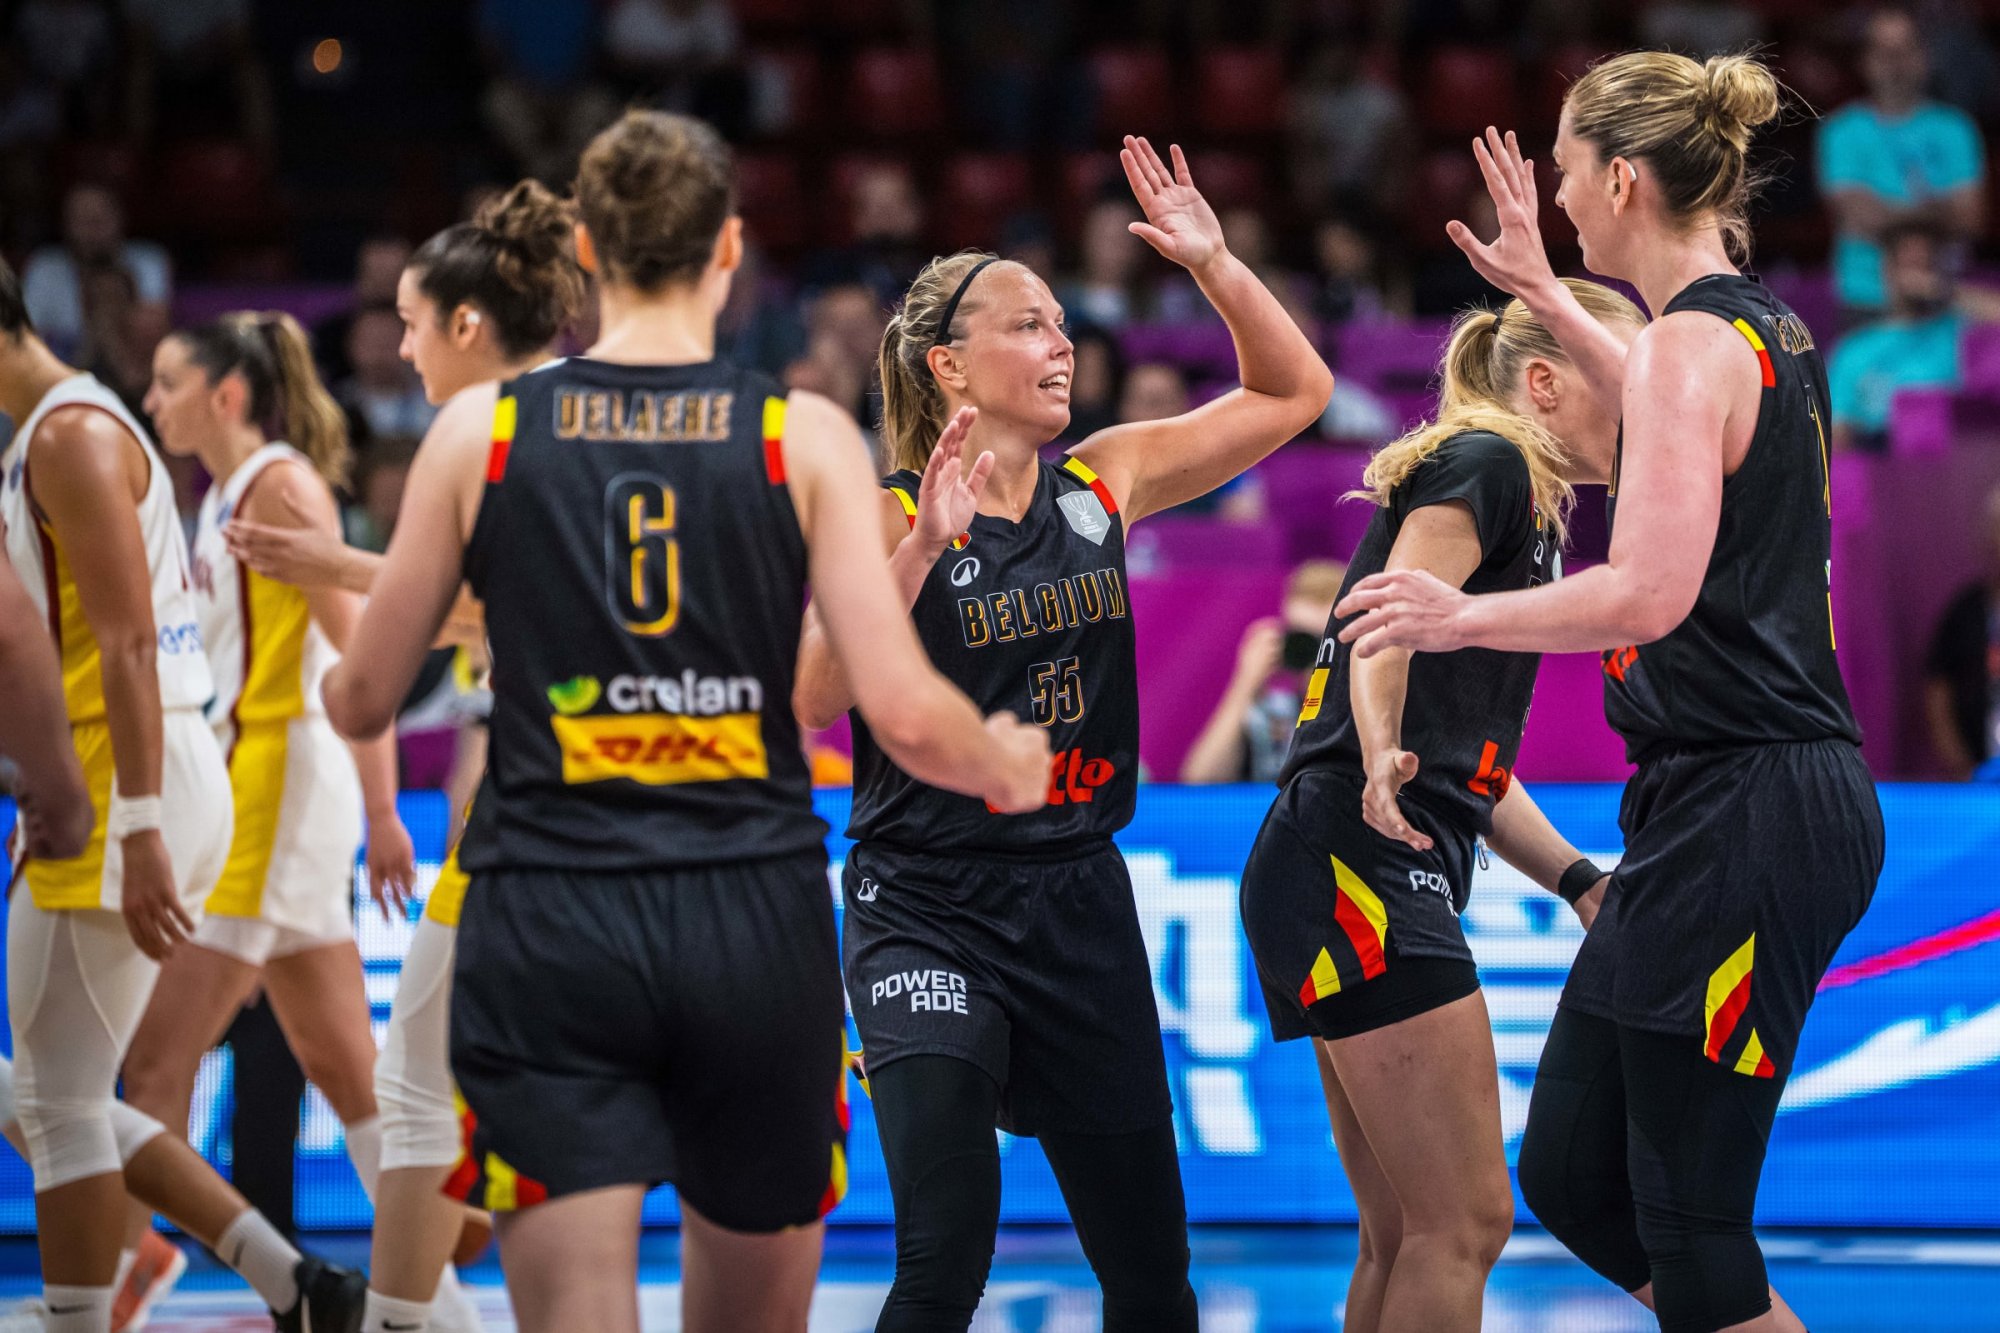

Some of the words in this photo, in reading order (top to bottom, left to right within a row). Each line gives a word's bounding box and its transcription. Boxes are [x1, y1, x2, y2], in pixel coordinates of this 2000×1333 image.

[604, 471, 681, 637] 6
[958, 568, 1125, 648] BELGIUM
[1028, 656, 1084, 727] 55
[872, 970, 967, 1006] POWER
[911, 991, 968, 1014] ADE
